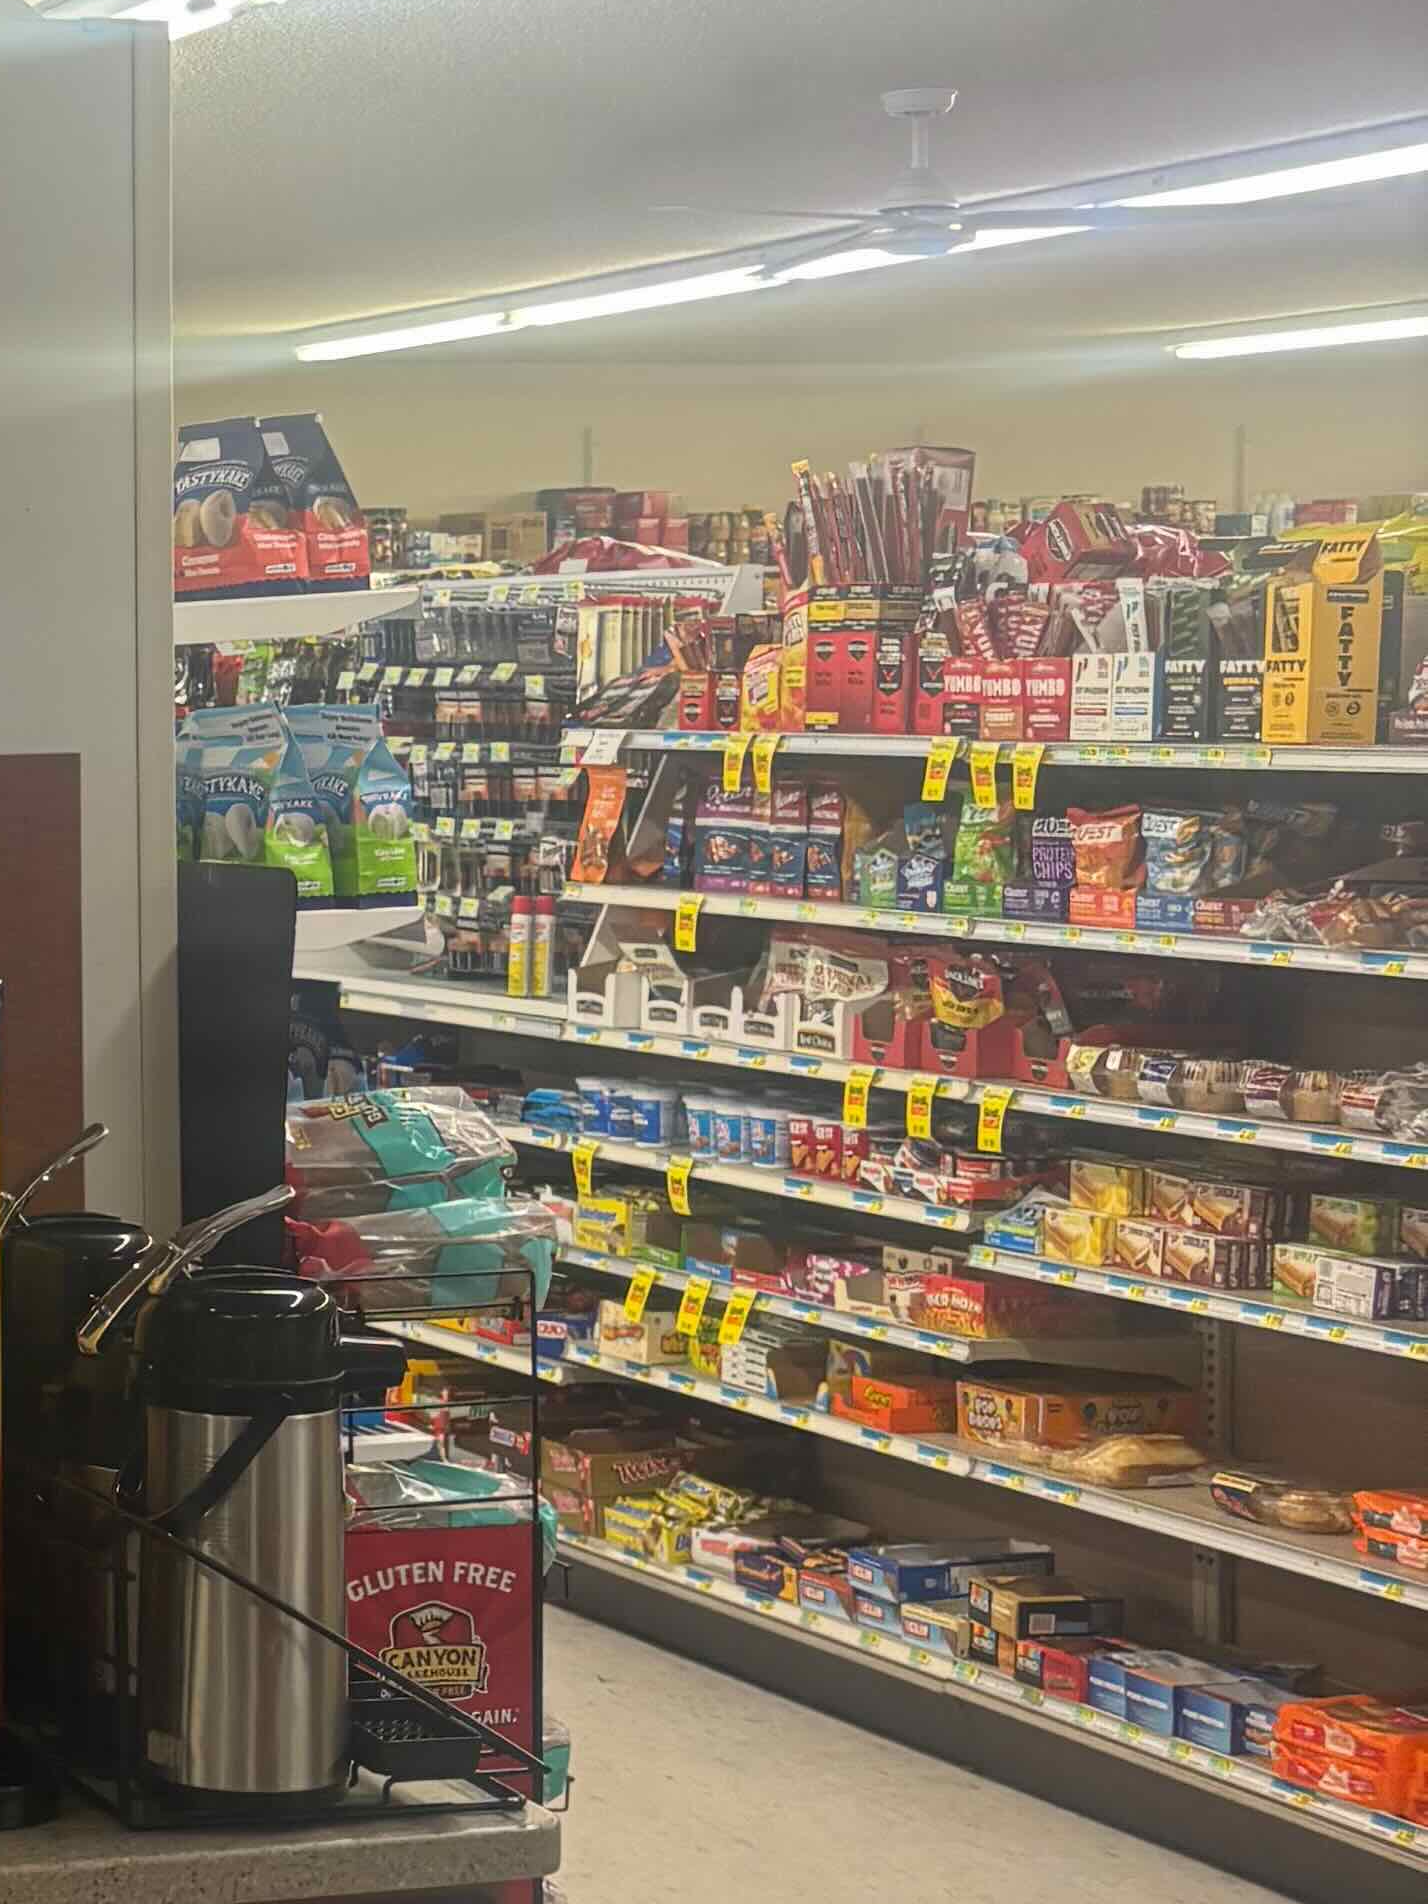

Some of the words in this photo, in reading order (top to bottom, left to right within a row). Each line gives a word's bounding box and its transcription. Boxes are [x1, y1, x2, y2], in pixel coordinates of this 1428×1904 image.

[176, 465, 251, 495] TASTYKAKE
[1321, 541, 1366, 554] FATTY
[1337, 606, 1355, 687] FATTY
[1164, 660, 1206, 674] FATTY
[1219, 660, 1265, 674] FATTY
[1265, 659, 1307, 673] FATTY
[1033, 861, 1073, 881] CHIPS
[346, 1559, 444, 1603] GLUTEN
[452, 1560, 517, 1593] FREE
[389, 1649, 477, 1670] CANYON
